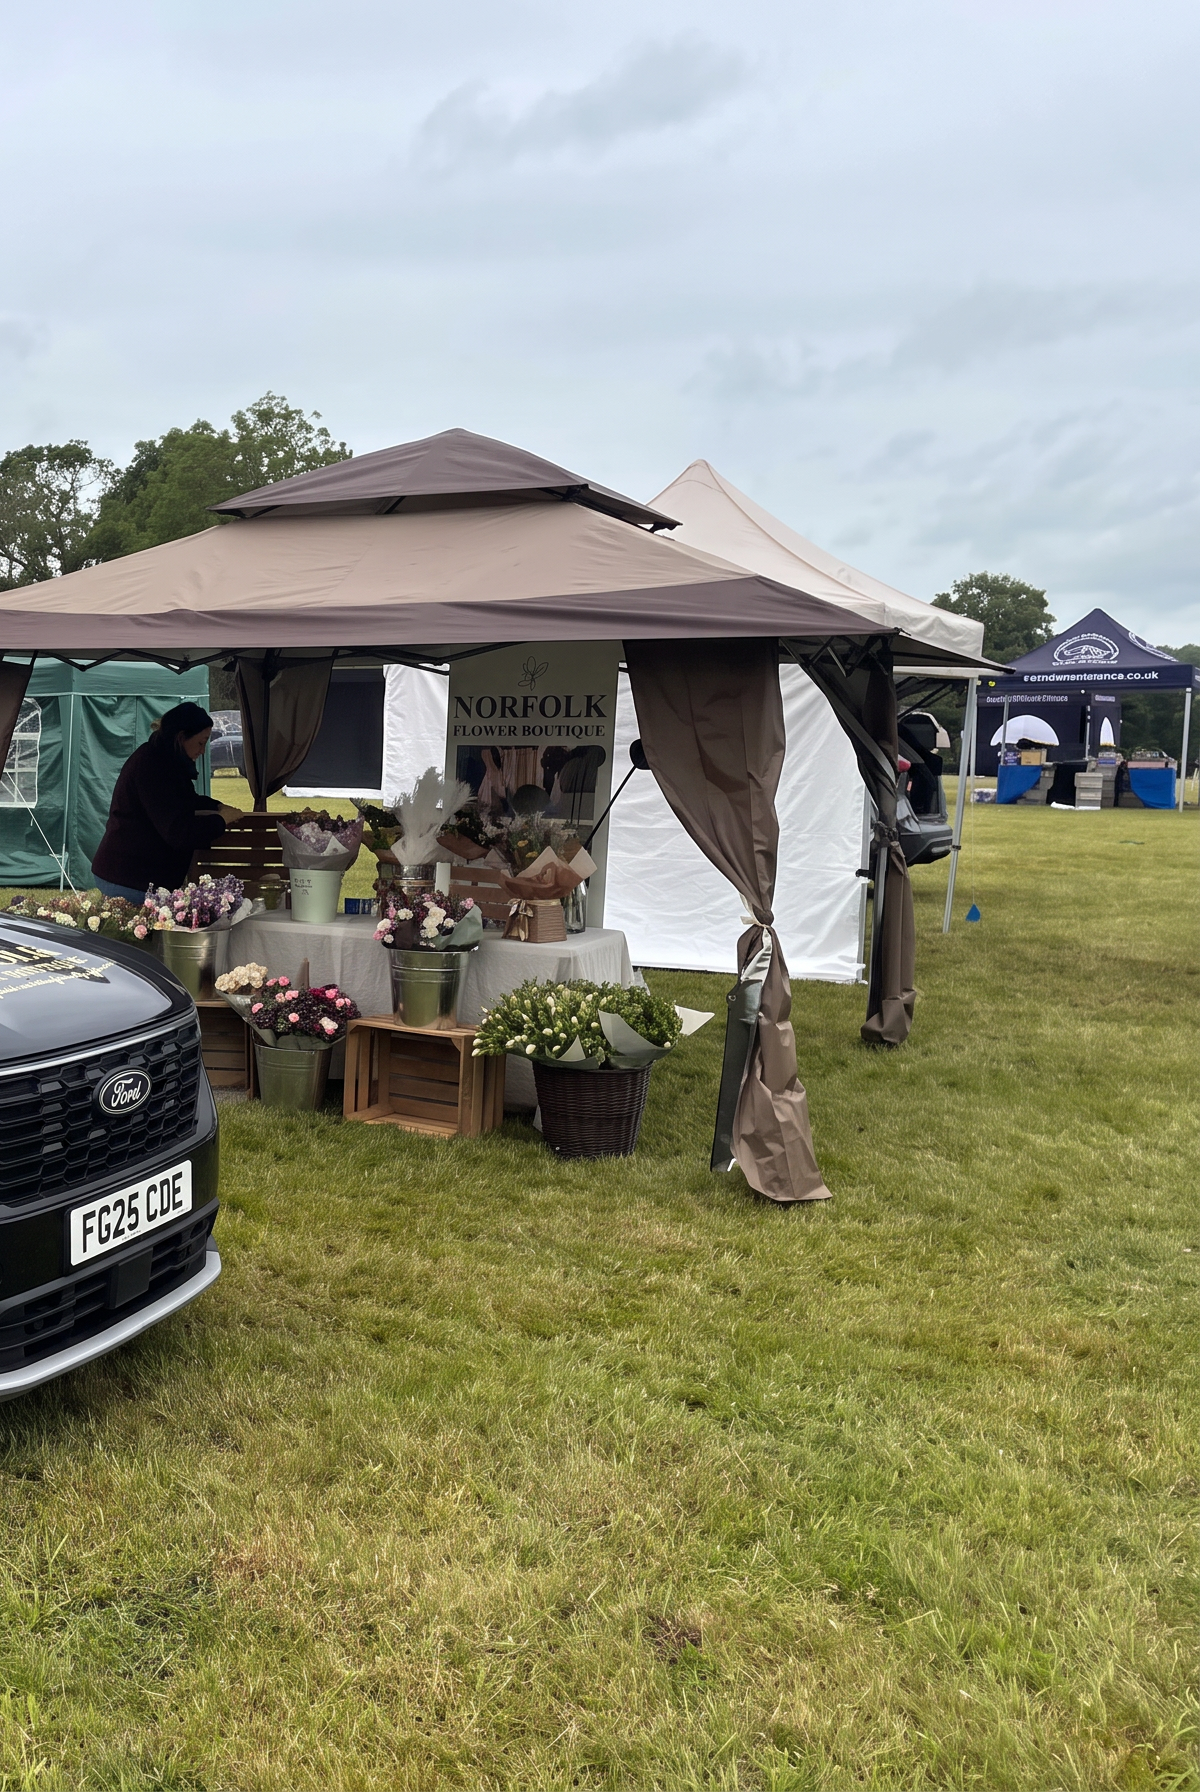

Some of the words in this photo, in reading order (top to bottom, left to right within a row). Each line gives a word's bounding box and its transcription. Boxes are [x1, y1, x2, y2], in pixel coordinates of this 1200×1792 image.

[453, 694, 607, 719] NORFOLK
[453, 725, 518, 737] FLOWER
[522, 725, 605, 739] BOUTIQUE
[111, 1077, 141, 1107] Ford
[82, 1191, 139, 1254] FG25
[146, 1171, 183, 1223] CDE
